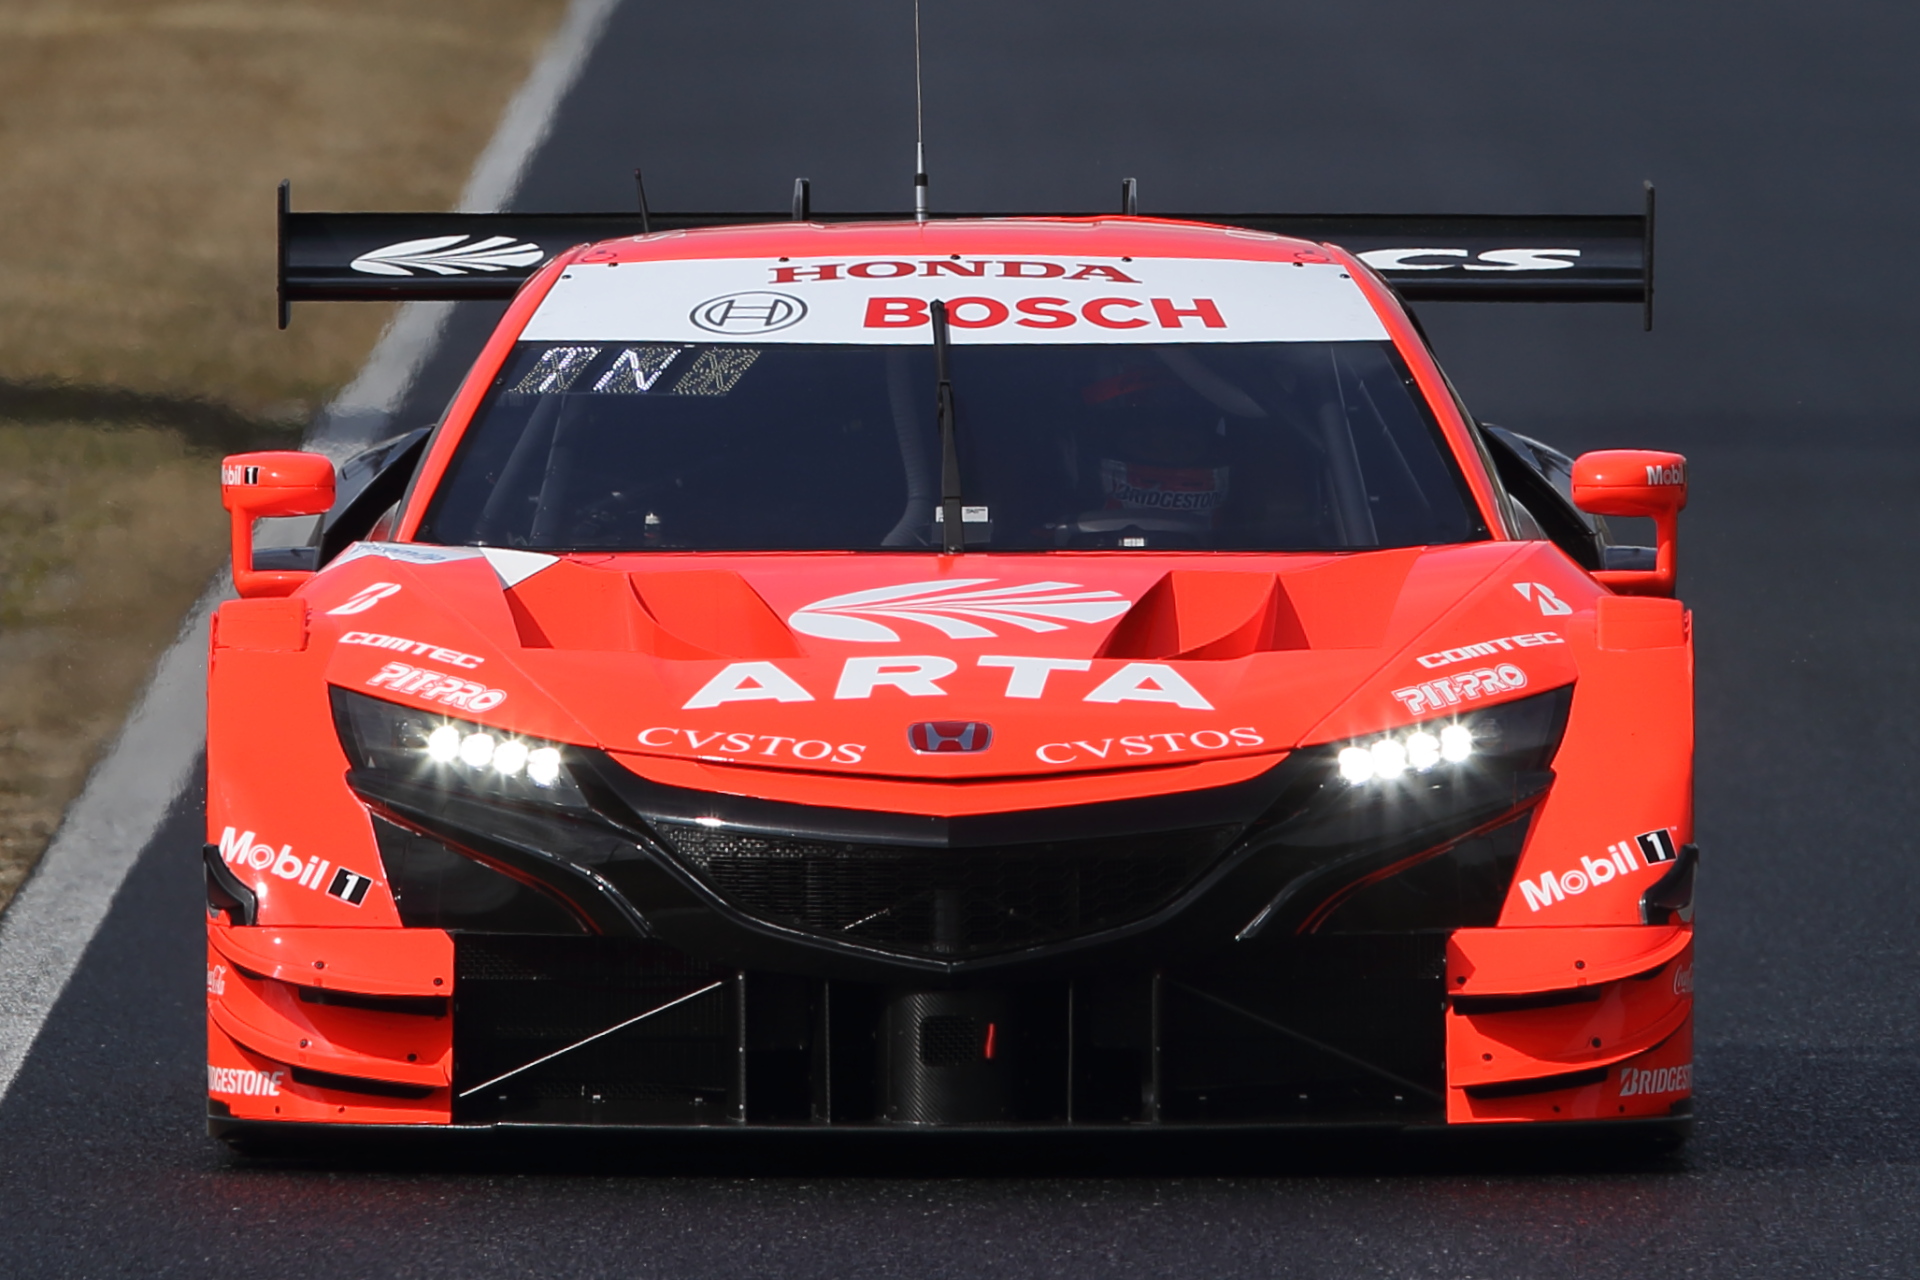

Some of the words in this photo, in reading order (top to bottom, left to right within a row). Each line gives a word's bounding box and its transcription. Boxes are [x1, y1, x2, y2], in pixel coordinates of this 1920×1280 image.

[767, 260, 1143, 284] HONDA
[863, 296, 1228, 329] BOSCH
[338, 631, 485, 669] COMTEC
[1416, 631, 1565, 669] COMTEC
[681, 655, 1216, 711] ARTA
[637, 727, 867, 764] CVSTOS
[1035, 727, 1265, 764] CVSTOS
[218, 826, 331, 891] Mobil
[1518, 840, 1640, 913] Mobil
